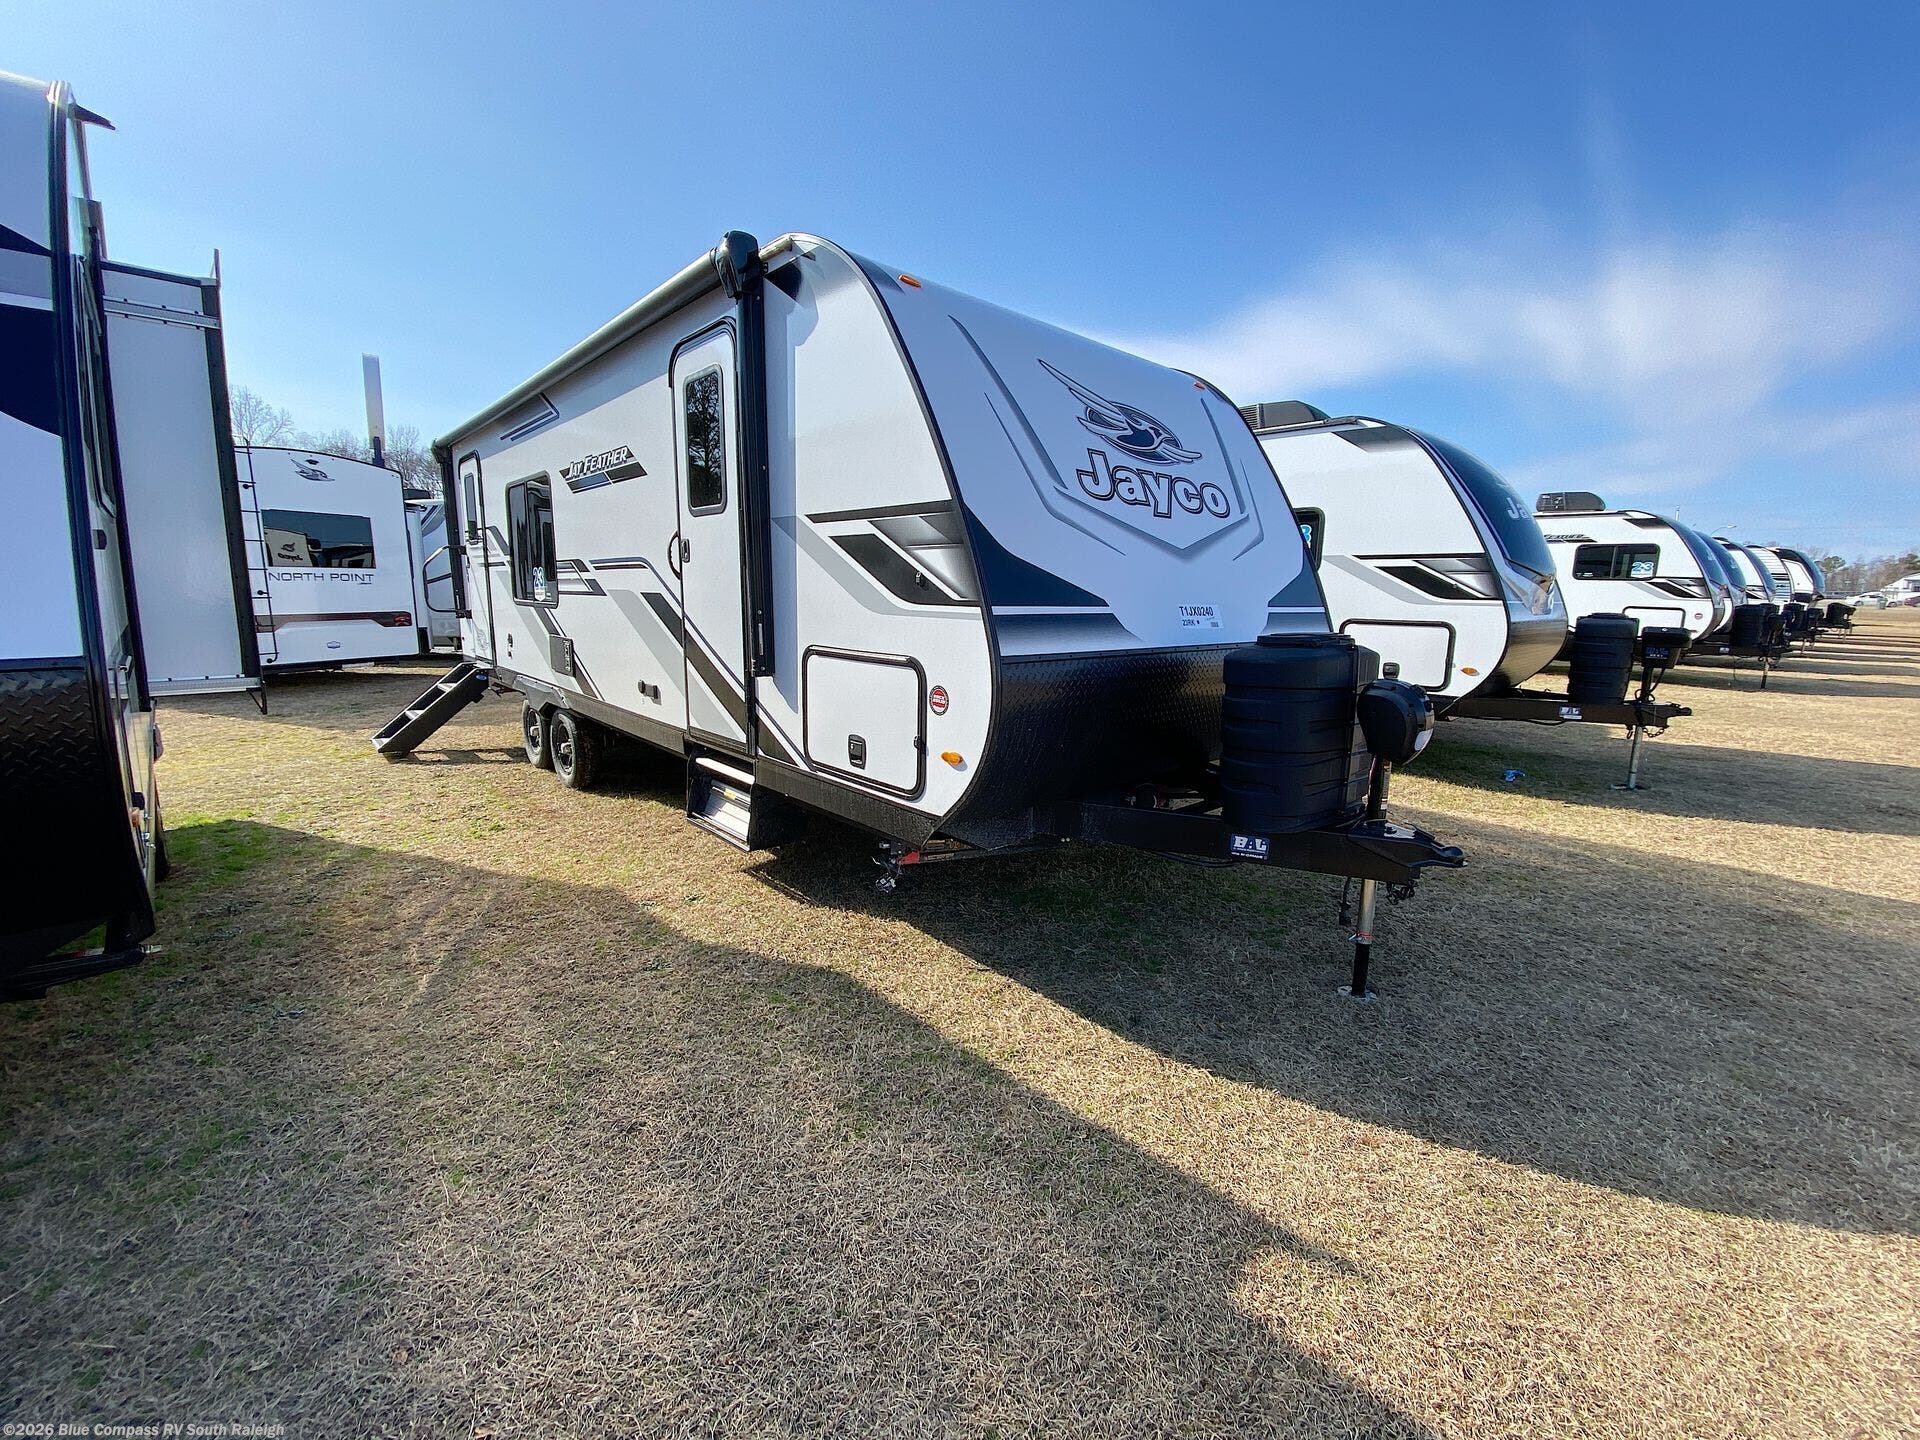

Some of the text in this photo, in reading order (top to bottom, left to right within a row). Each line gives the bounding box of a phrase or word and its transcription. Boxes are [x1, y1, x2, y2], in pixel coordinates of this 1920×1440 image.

[565, 447, 628, 479] JAY FEATHER
[1076, 448, 1231, 519] Jayco
[268, 572, 374, 583] NORTH POINT
